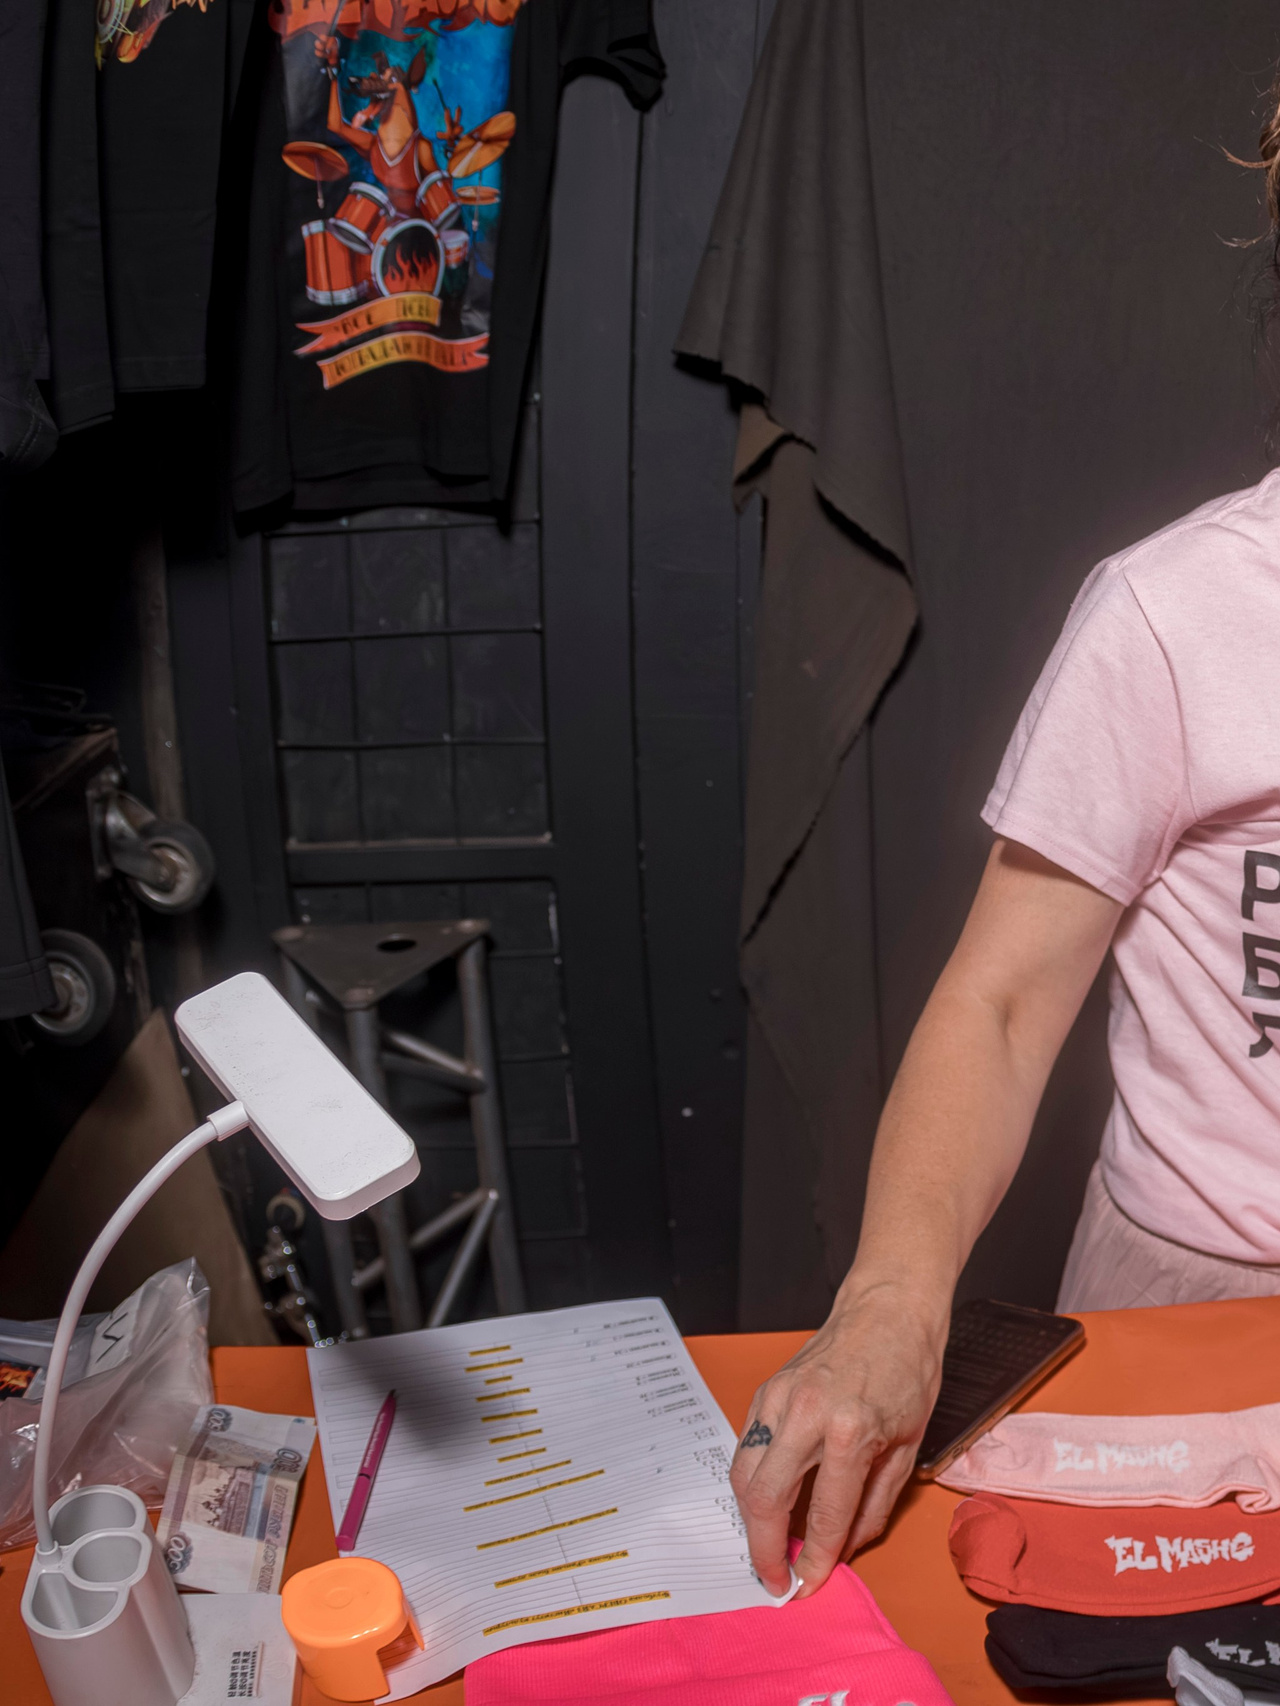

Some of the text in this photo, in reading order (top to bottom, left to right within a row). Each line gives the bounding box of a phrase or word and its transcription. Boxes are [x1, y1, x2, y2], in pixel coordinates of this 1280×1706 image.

[207, 1408, 226, 1431] 500
[1054, 1439, 1093, 1473] EL
[165, 1536, 189, 1574] 500
[1104, 1533, 1158, 1576] EL
[1205, 1638, 1266, 1667] EL
